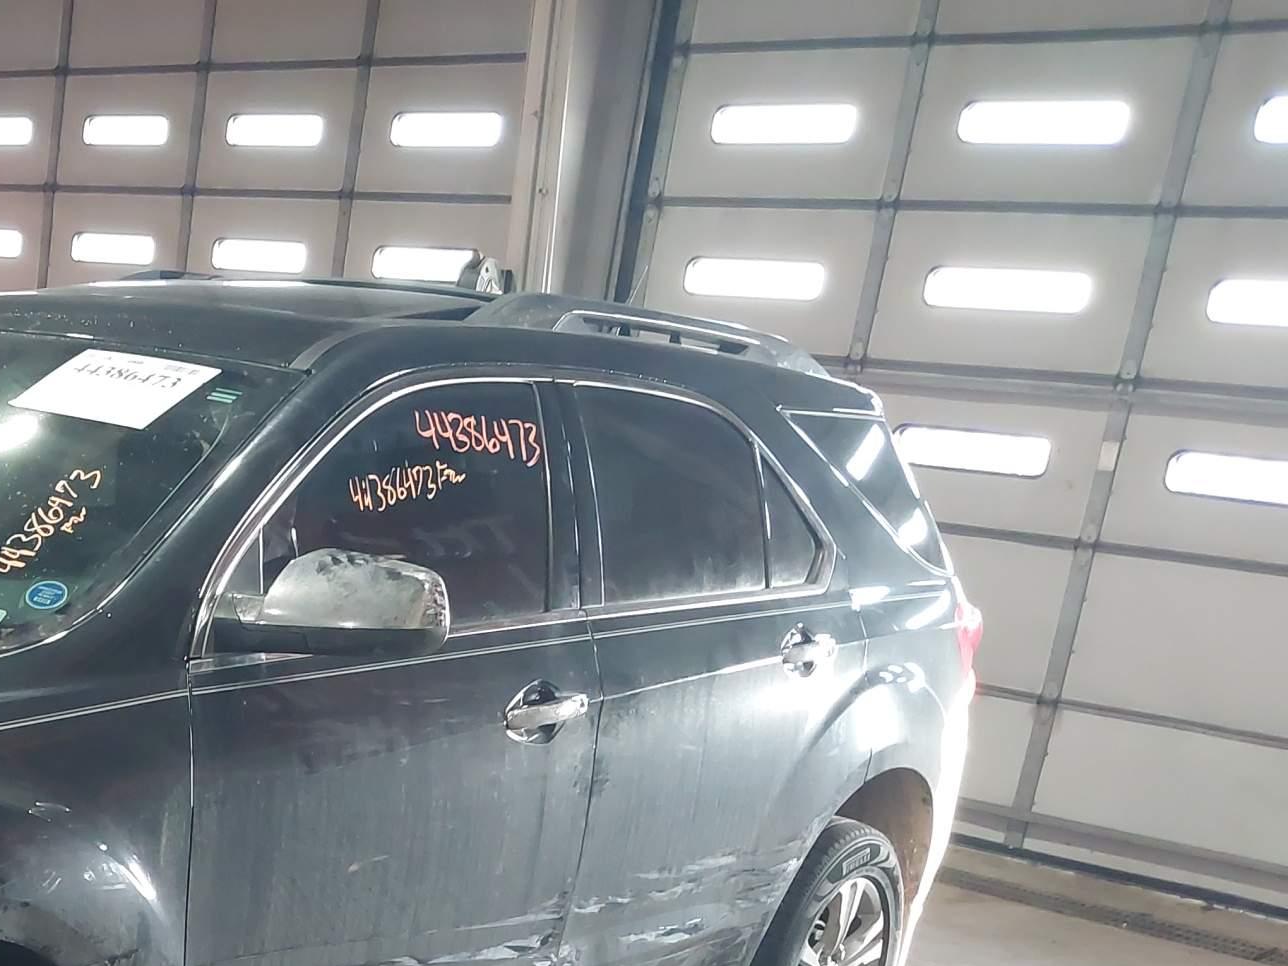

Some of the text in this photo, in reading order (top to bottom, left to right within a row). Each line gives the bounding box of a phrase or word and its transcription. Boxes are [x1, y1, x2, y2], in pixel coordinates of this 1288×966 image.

[74, 362, 182, 388] 44386473
[414, 409, 541, 468] 44386473
[349, 464, 436, 512] 44386473
